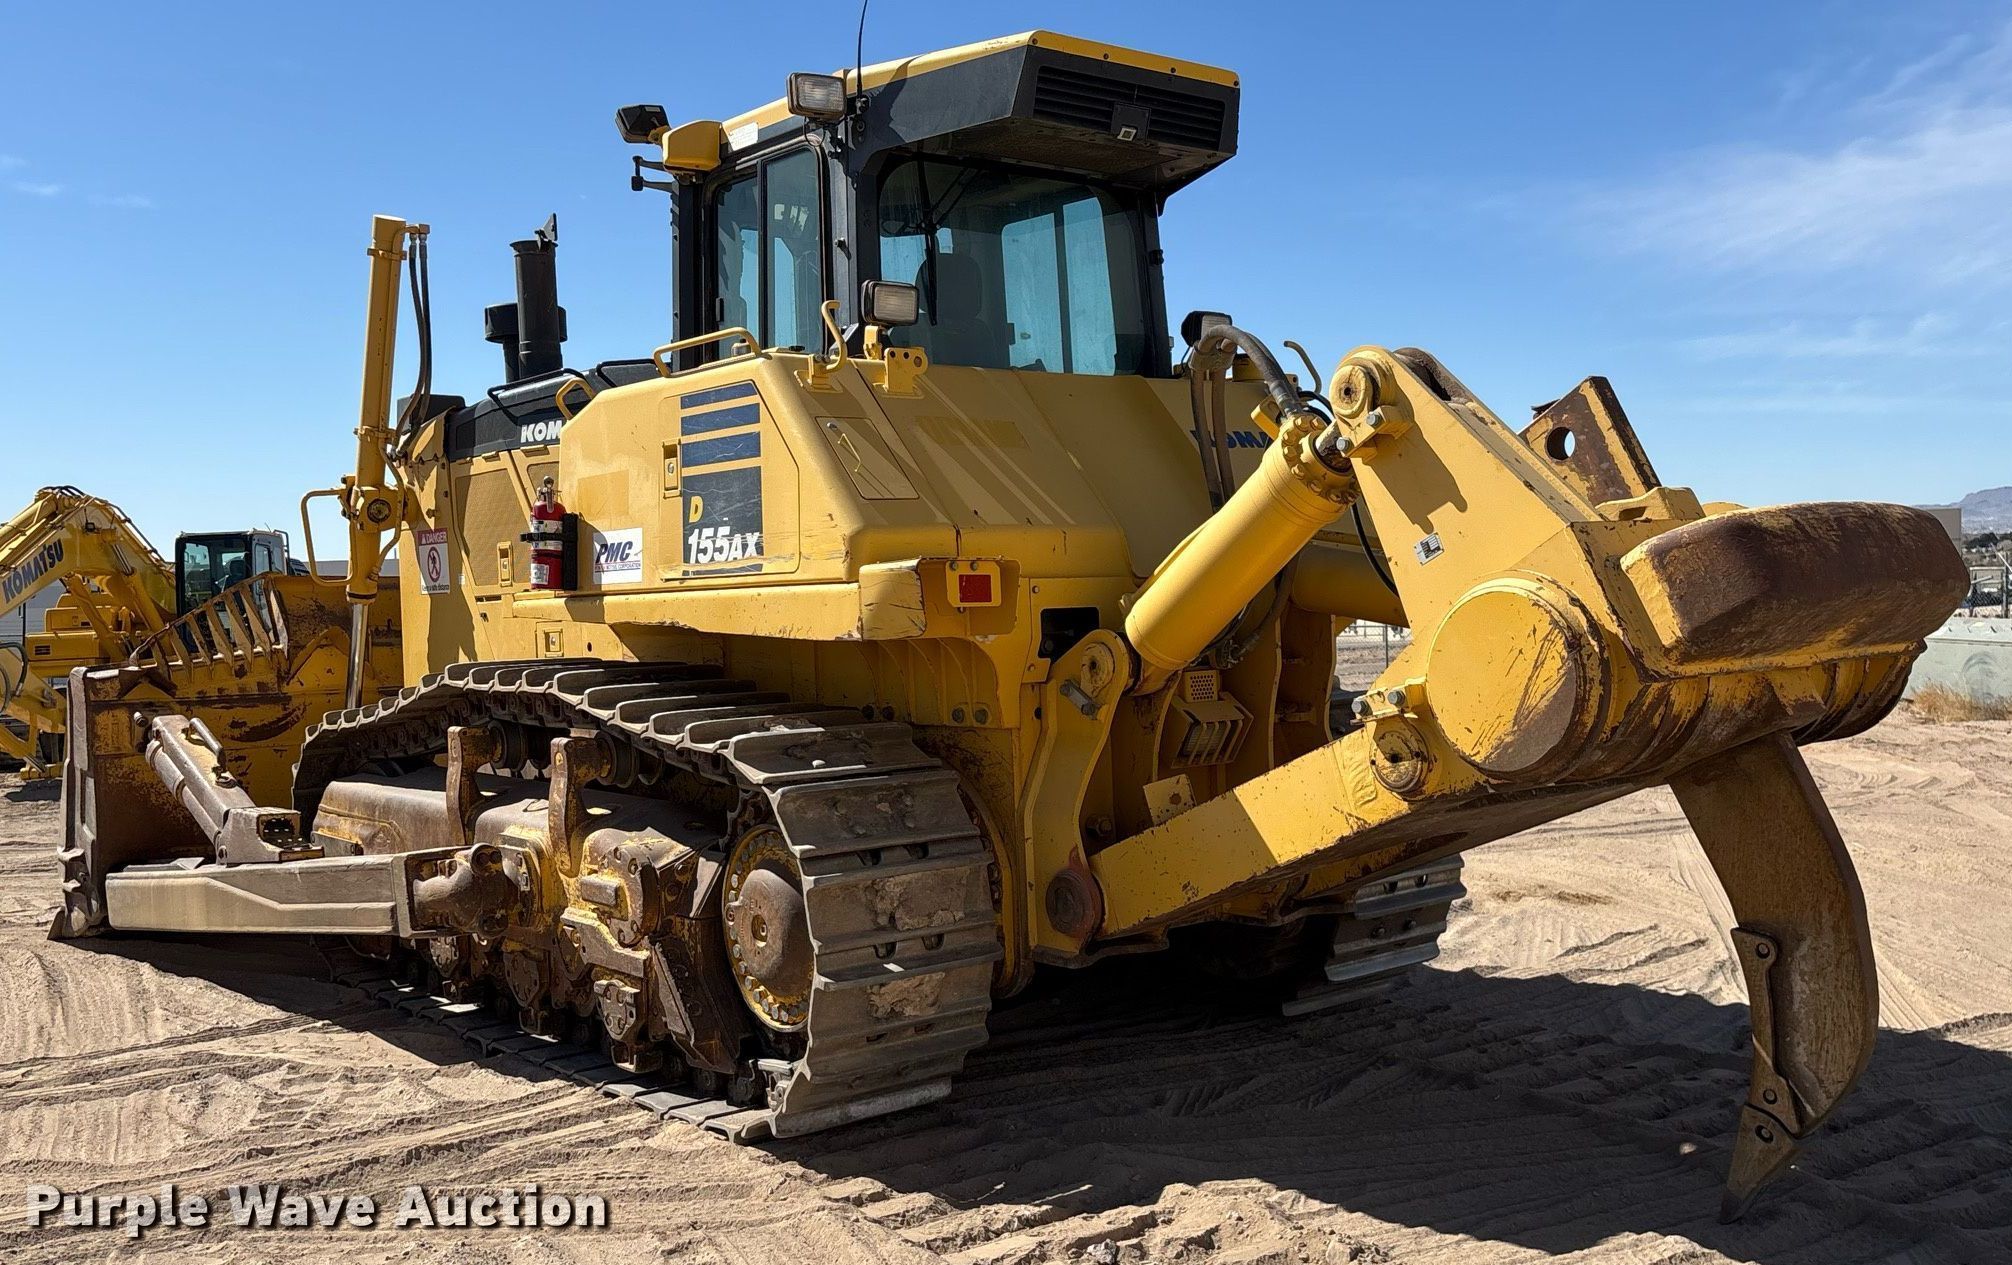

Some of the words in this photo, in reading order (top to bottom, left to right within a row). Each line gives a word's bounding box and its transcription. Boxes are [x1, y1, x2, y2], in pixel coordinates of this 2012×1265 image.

[689, 495, 704, 523] D
[426, 531, 448, 544] DANGER
[688, 526, 760, 564] 155AX
[595, 541, 633, 564] PMC
[2, 538, 64, 604] KOMATSU
